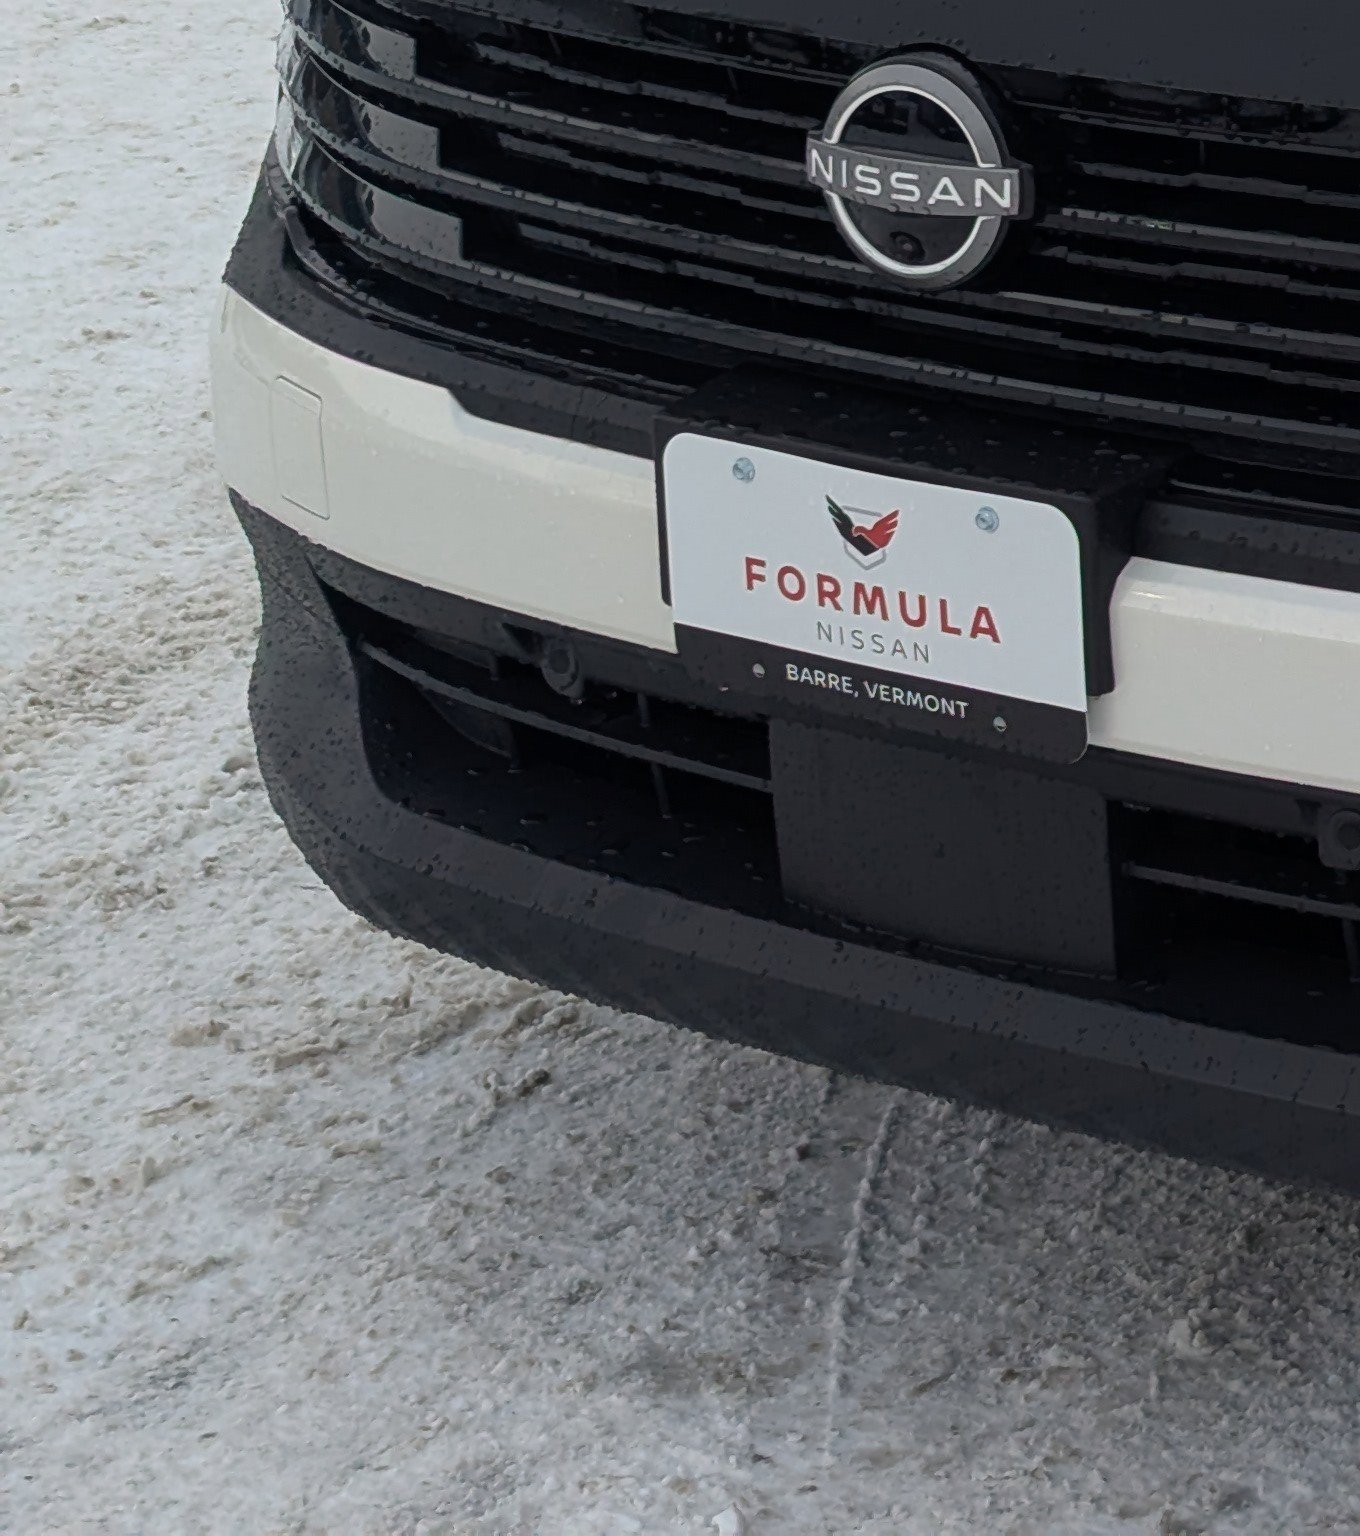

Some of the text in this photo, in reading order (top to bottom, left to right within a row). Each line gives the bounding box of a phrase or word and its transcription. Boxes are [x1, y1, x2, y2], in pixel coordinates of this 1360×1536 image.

[811, 148, 1012, 208] NISSAN
[745, 556, 1001, 644] FORMULA
[817, 621, 930, 663] NISSAN
[786, 663, 970, 719] BARRE, VERMONT
